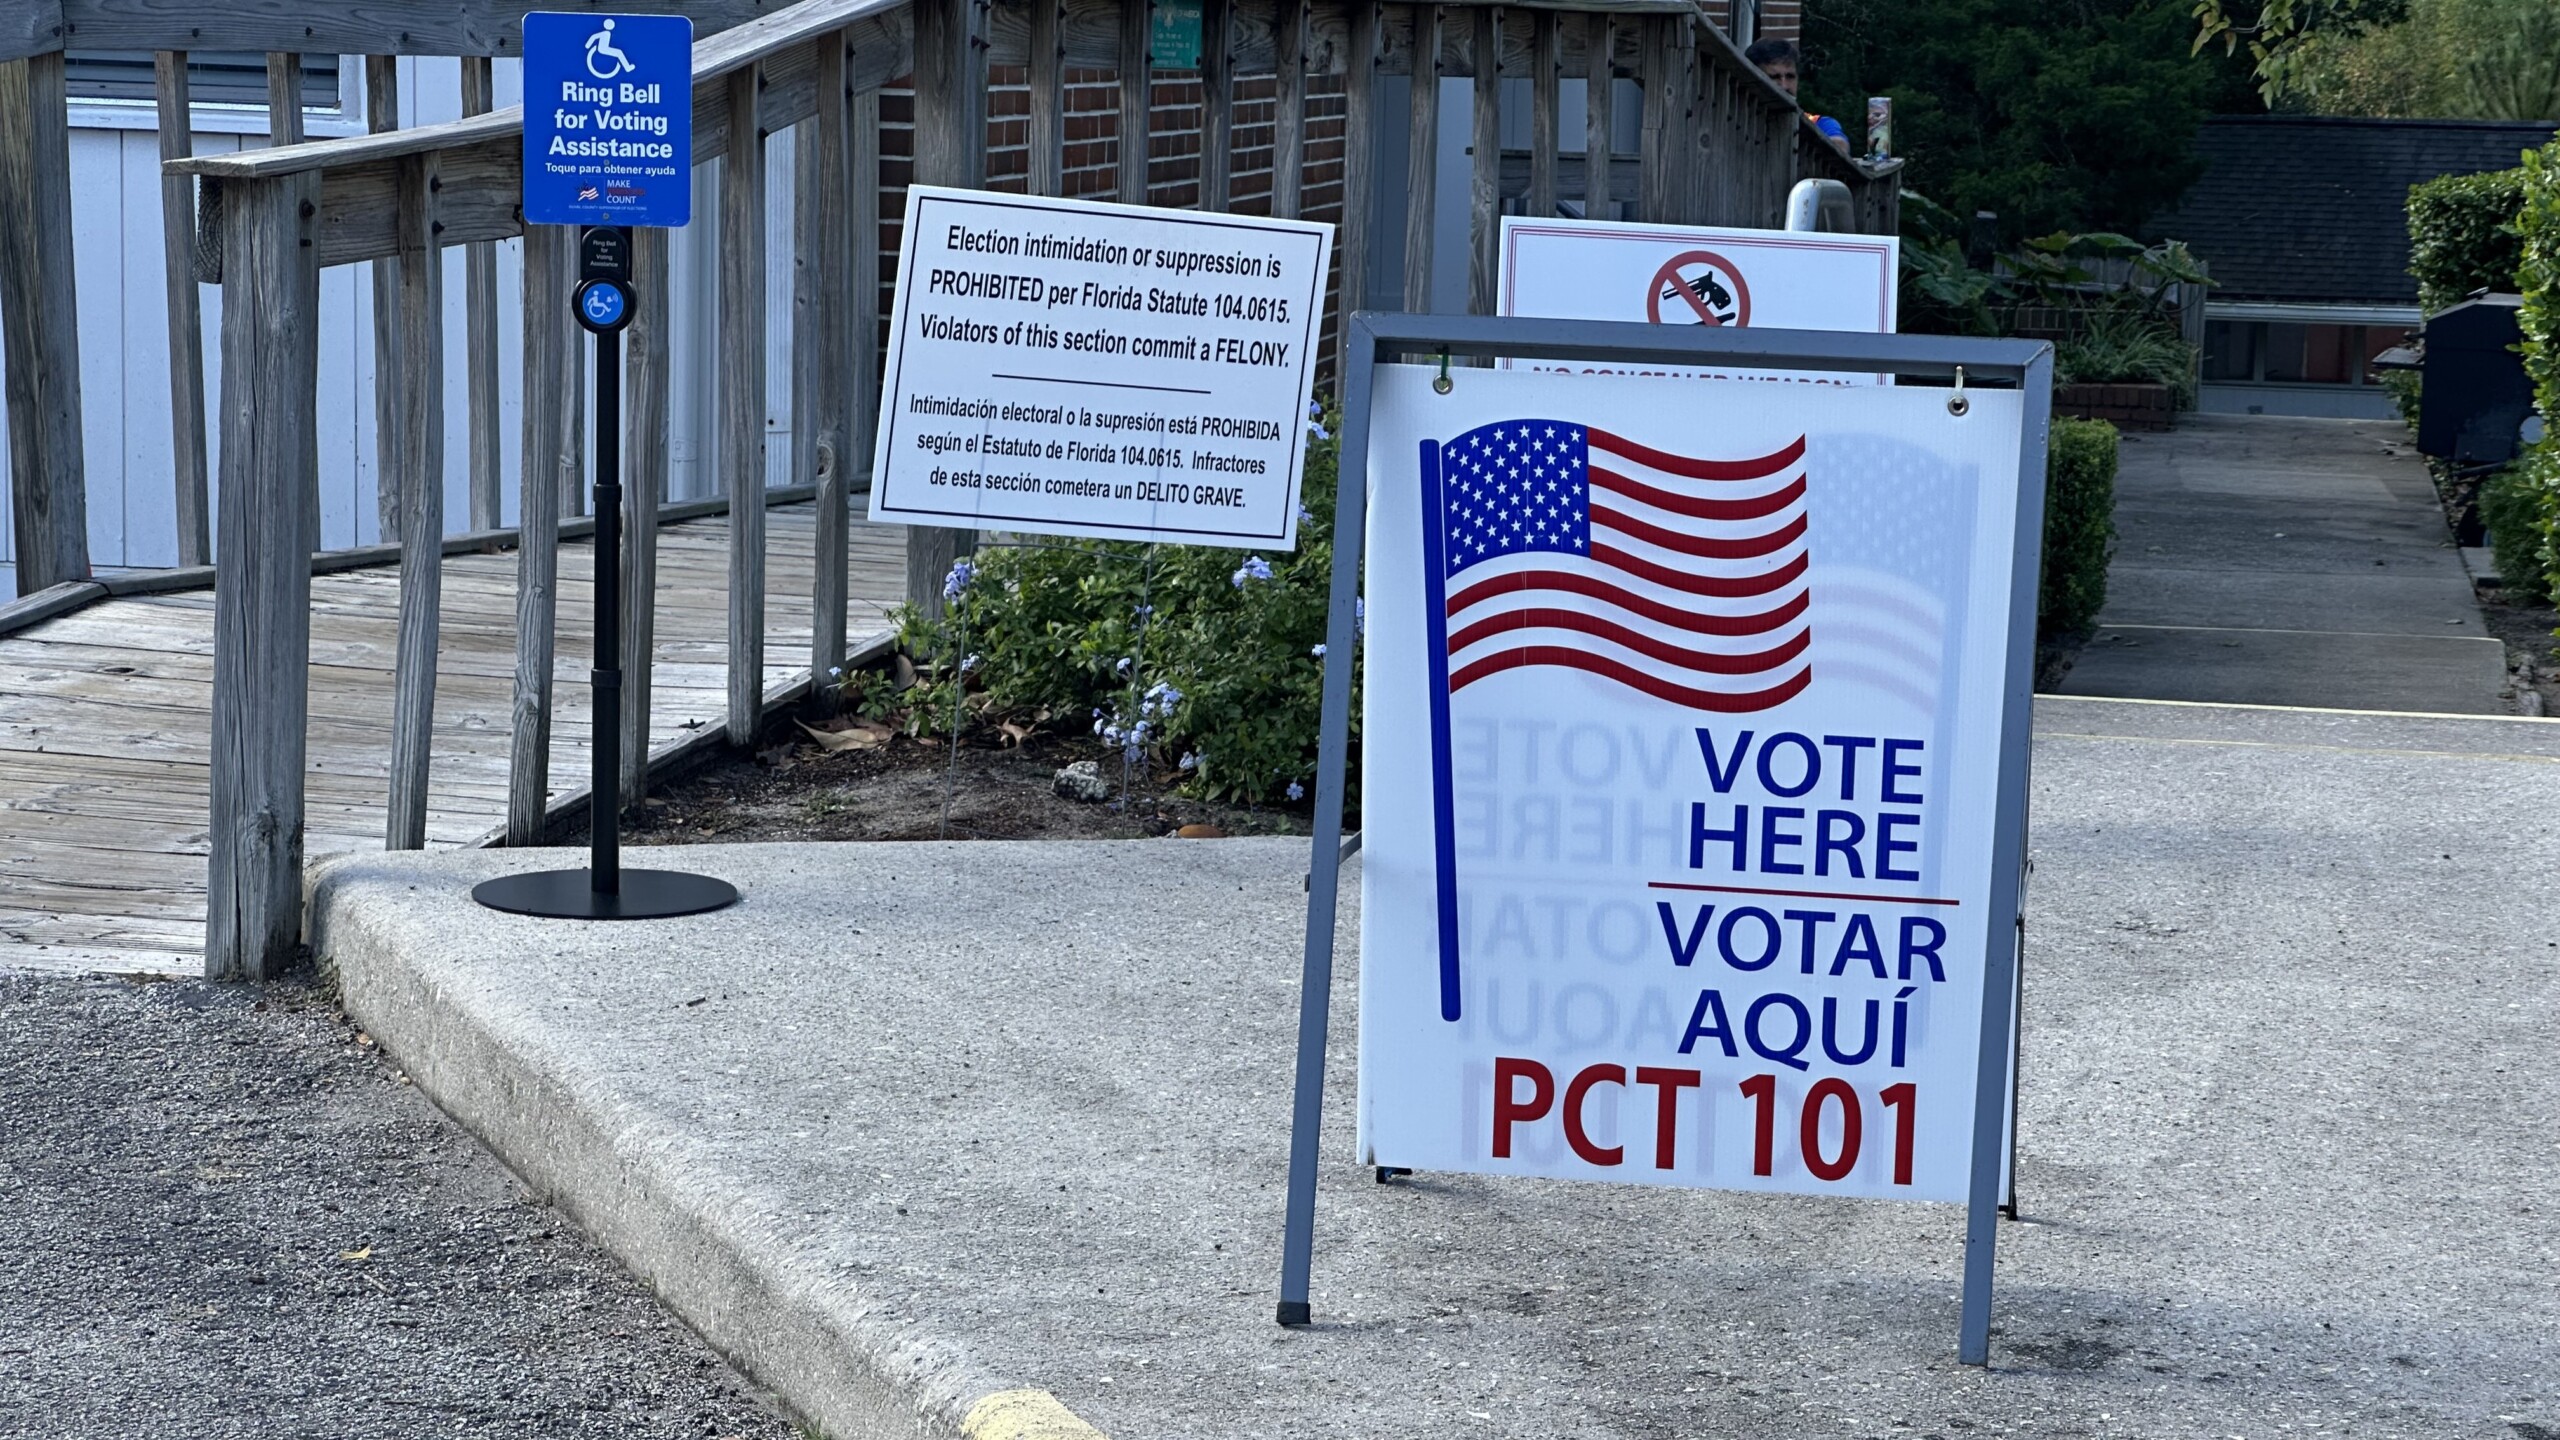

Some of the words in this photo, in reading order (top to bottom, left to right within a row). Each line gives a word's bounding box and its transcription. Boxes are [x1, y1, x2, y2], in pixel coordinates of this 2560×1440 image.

[562, 81, 613, 107] Ring
[620, 83, 660, 104] Bell
[548, 135, 673, 158] Assistance
[554, 109, 588, 129] for
[594, 110, 668, 136] Voting
[545, 162, 577, 174] Toque
[579, 165, 601, 175] para
[603, 163, 643, 175] obtener
[645, 166, 676, 177] ayuda
[607, 179, 631, 188] MAKE
[606, 195, 637, 204] COUNT
[947, 225, 1019, 255] Election
[1024, 232, 1127, 265] intimidation
[1133, 248, 1152, 267] or
[1155, 250, 1261, 277] suppression
[1266, 253, 1281, 278] is
[929, 269, 1044, 302] PROHIBITED
[1047, 284, 1078, 310] per
[1082, 282, 1142, 311] Florida
[1147, 287, 1208, 317] Statute
[1214, 293, 1291, 324] 104.0615.
[921, 313, 998, 344] Violators
[1003, 321, 1023, 346] of
[1026, 323, 1058, 349] this
[1063, 328, 1127, 354] section
[1132, 335, 1196, 360] commit
[1200, 342, 1210, 361] a
[1215, 337, 1290, 368] FELONY.
[910, 393, 998, 419] Intimidación
[1002, 401, 1063, 425] electoral
[1066, 410, 1075, 425] o
[1080, 407, 1092, 427] la
[1095, 412, 1165, 434] supresión
[1168, 415, 1197, 435] está
[1201, 417, 1281, 441] PROHIBIDA
[917, 431, 961, 455] según
[965, 433, 979, 453] el
[982, 434, 1042, 458] Estatuto
[1045, 440, 1063, 459] de
[1067, 441, 1116, 464] Florida
[1120, 445, 1184, 468] 104.0615.
[1192, 450, 1266, 474] Infractores
[930, 466, 947, 486] de
[951, 469, 981, 488] esta
[985, 472, 1041, 493] sección
[1045, 478, 1110, 498] cometera
[1115, 484, 1132, 500] un
[1136, 481, 1189, 504] DELITO
[1193, 485, 1246, 508] GRAVE.
[1694, 727, 1925, 805] VOTE
[1689, 801, 1921, 882] HERE
[1656, 901, 1948, 983] VOTAR
[1676, 986, 1919, 1072] AQUÍ
[1491, 1056, 1702, 1170] PCT
[1738, 1073, 1917, 1186] 101
